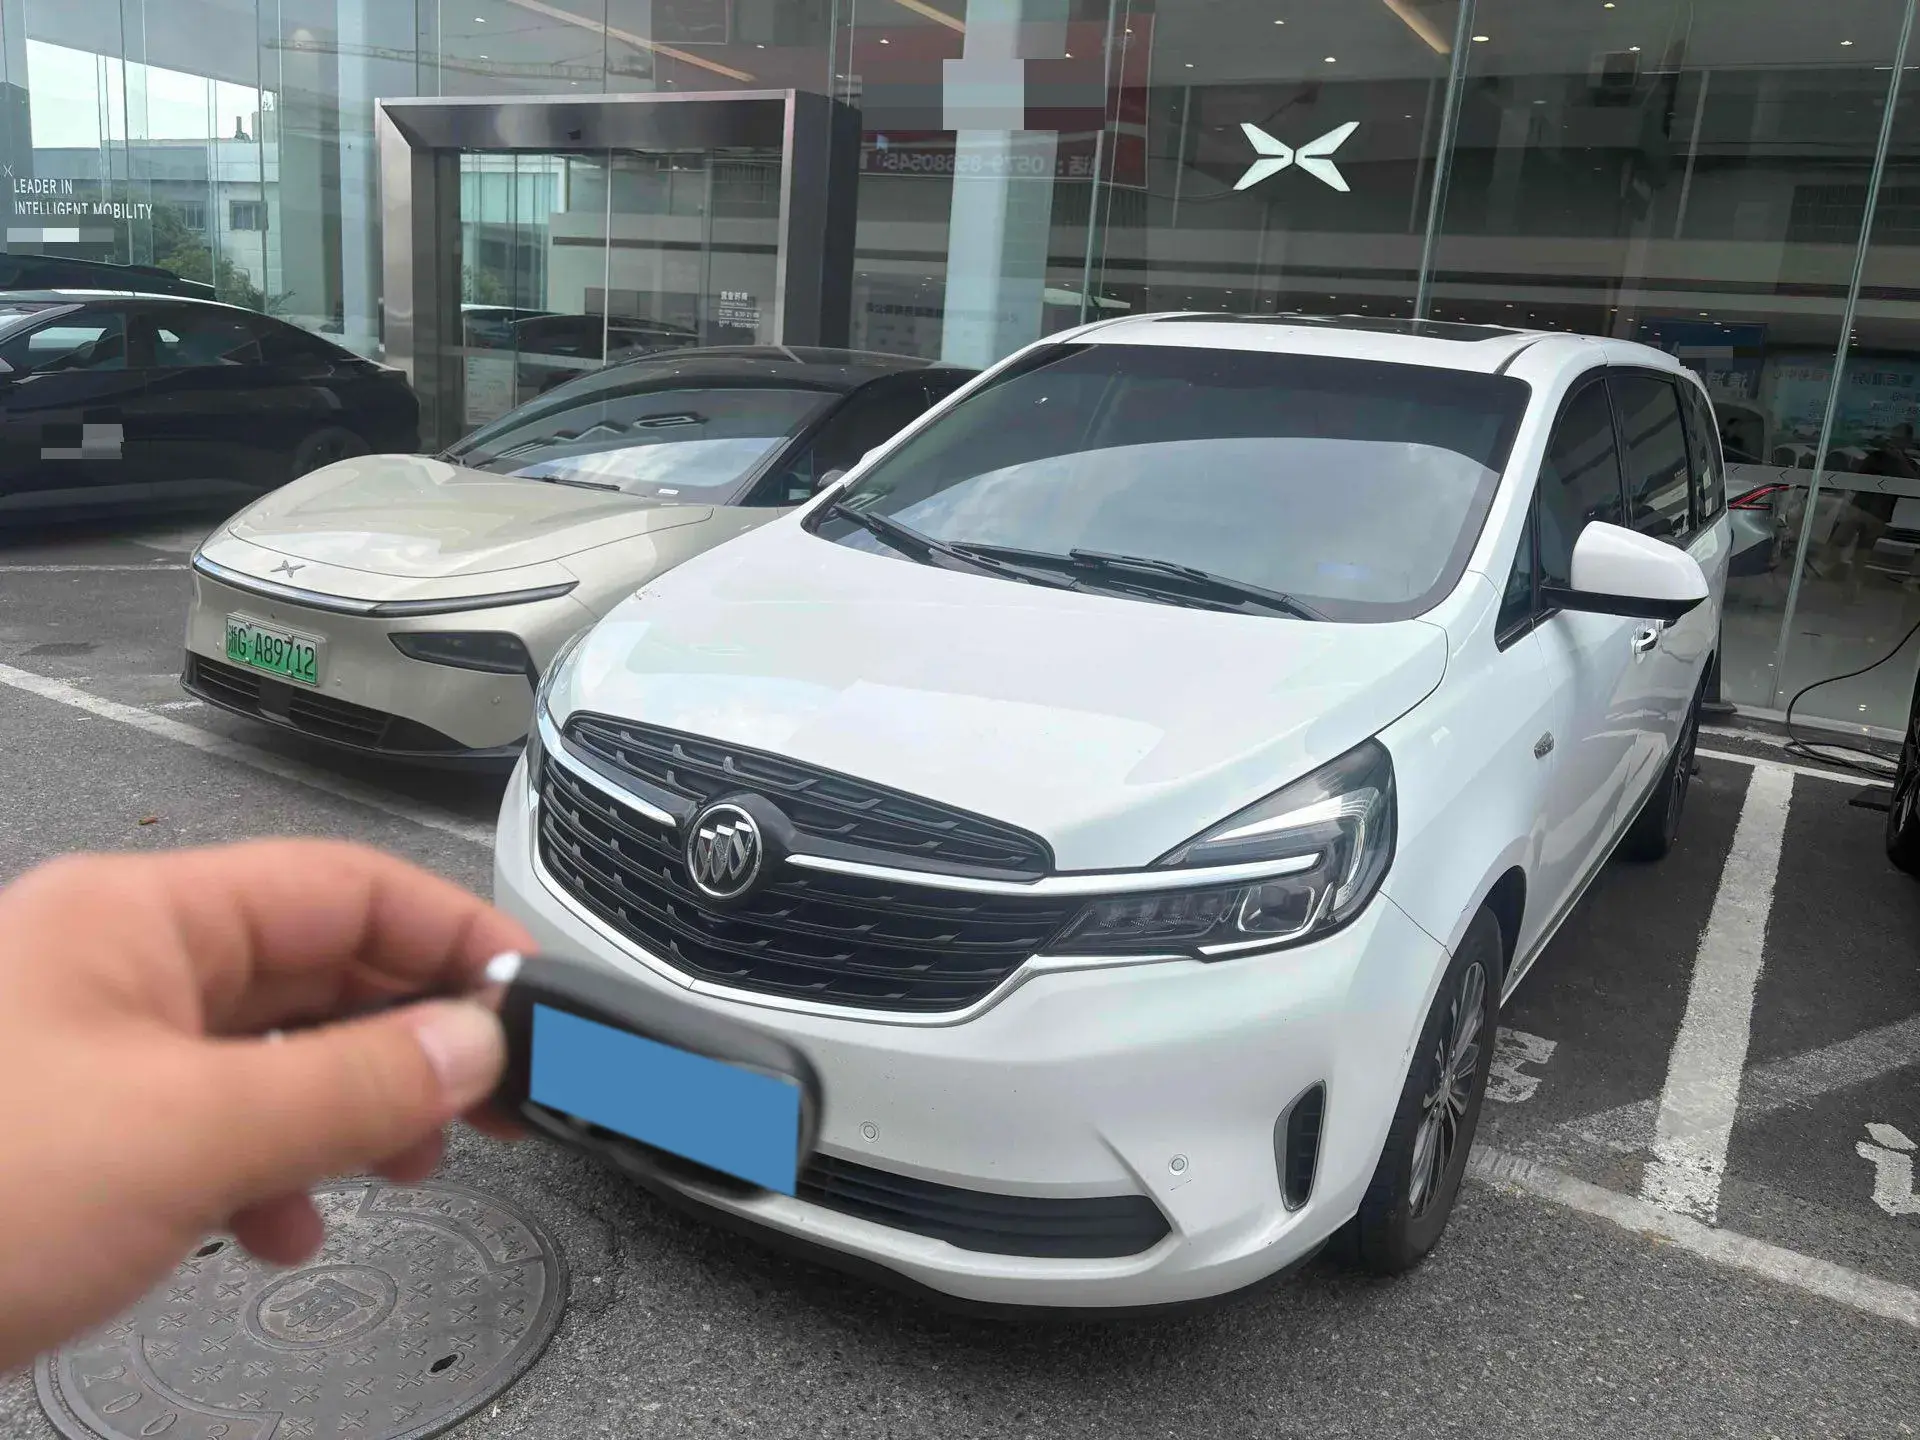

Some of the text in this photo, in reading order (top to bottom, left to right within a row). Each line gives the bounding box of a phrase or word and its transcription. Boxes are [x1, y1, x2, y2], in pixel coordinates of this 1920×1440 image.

[13, 179, 73, 195] LEADER IN
[15, 201, 153, 219] INTELLIGENT MOBILITY
